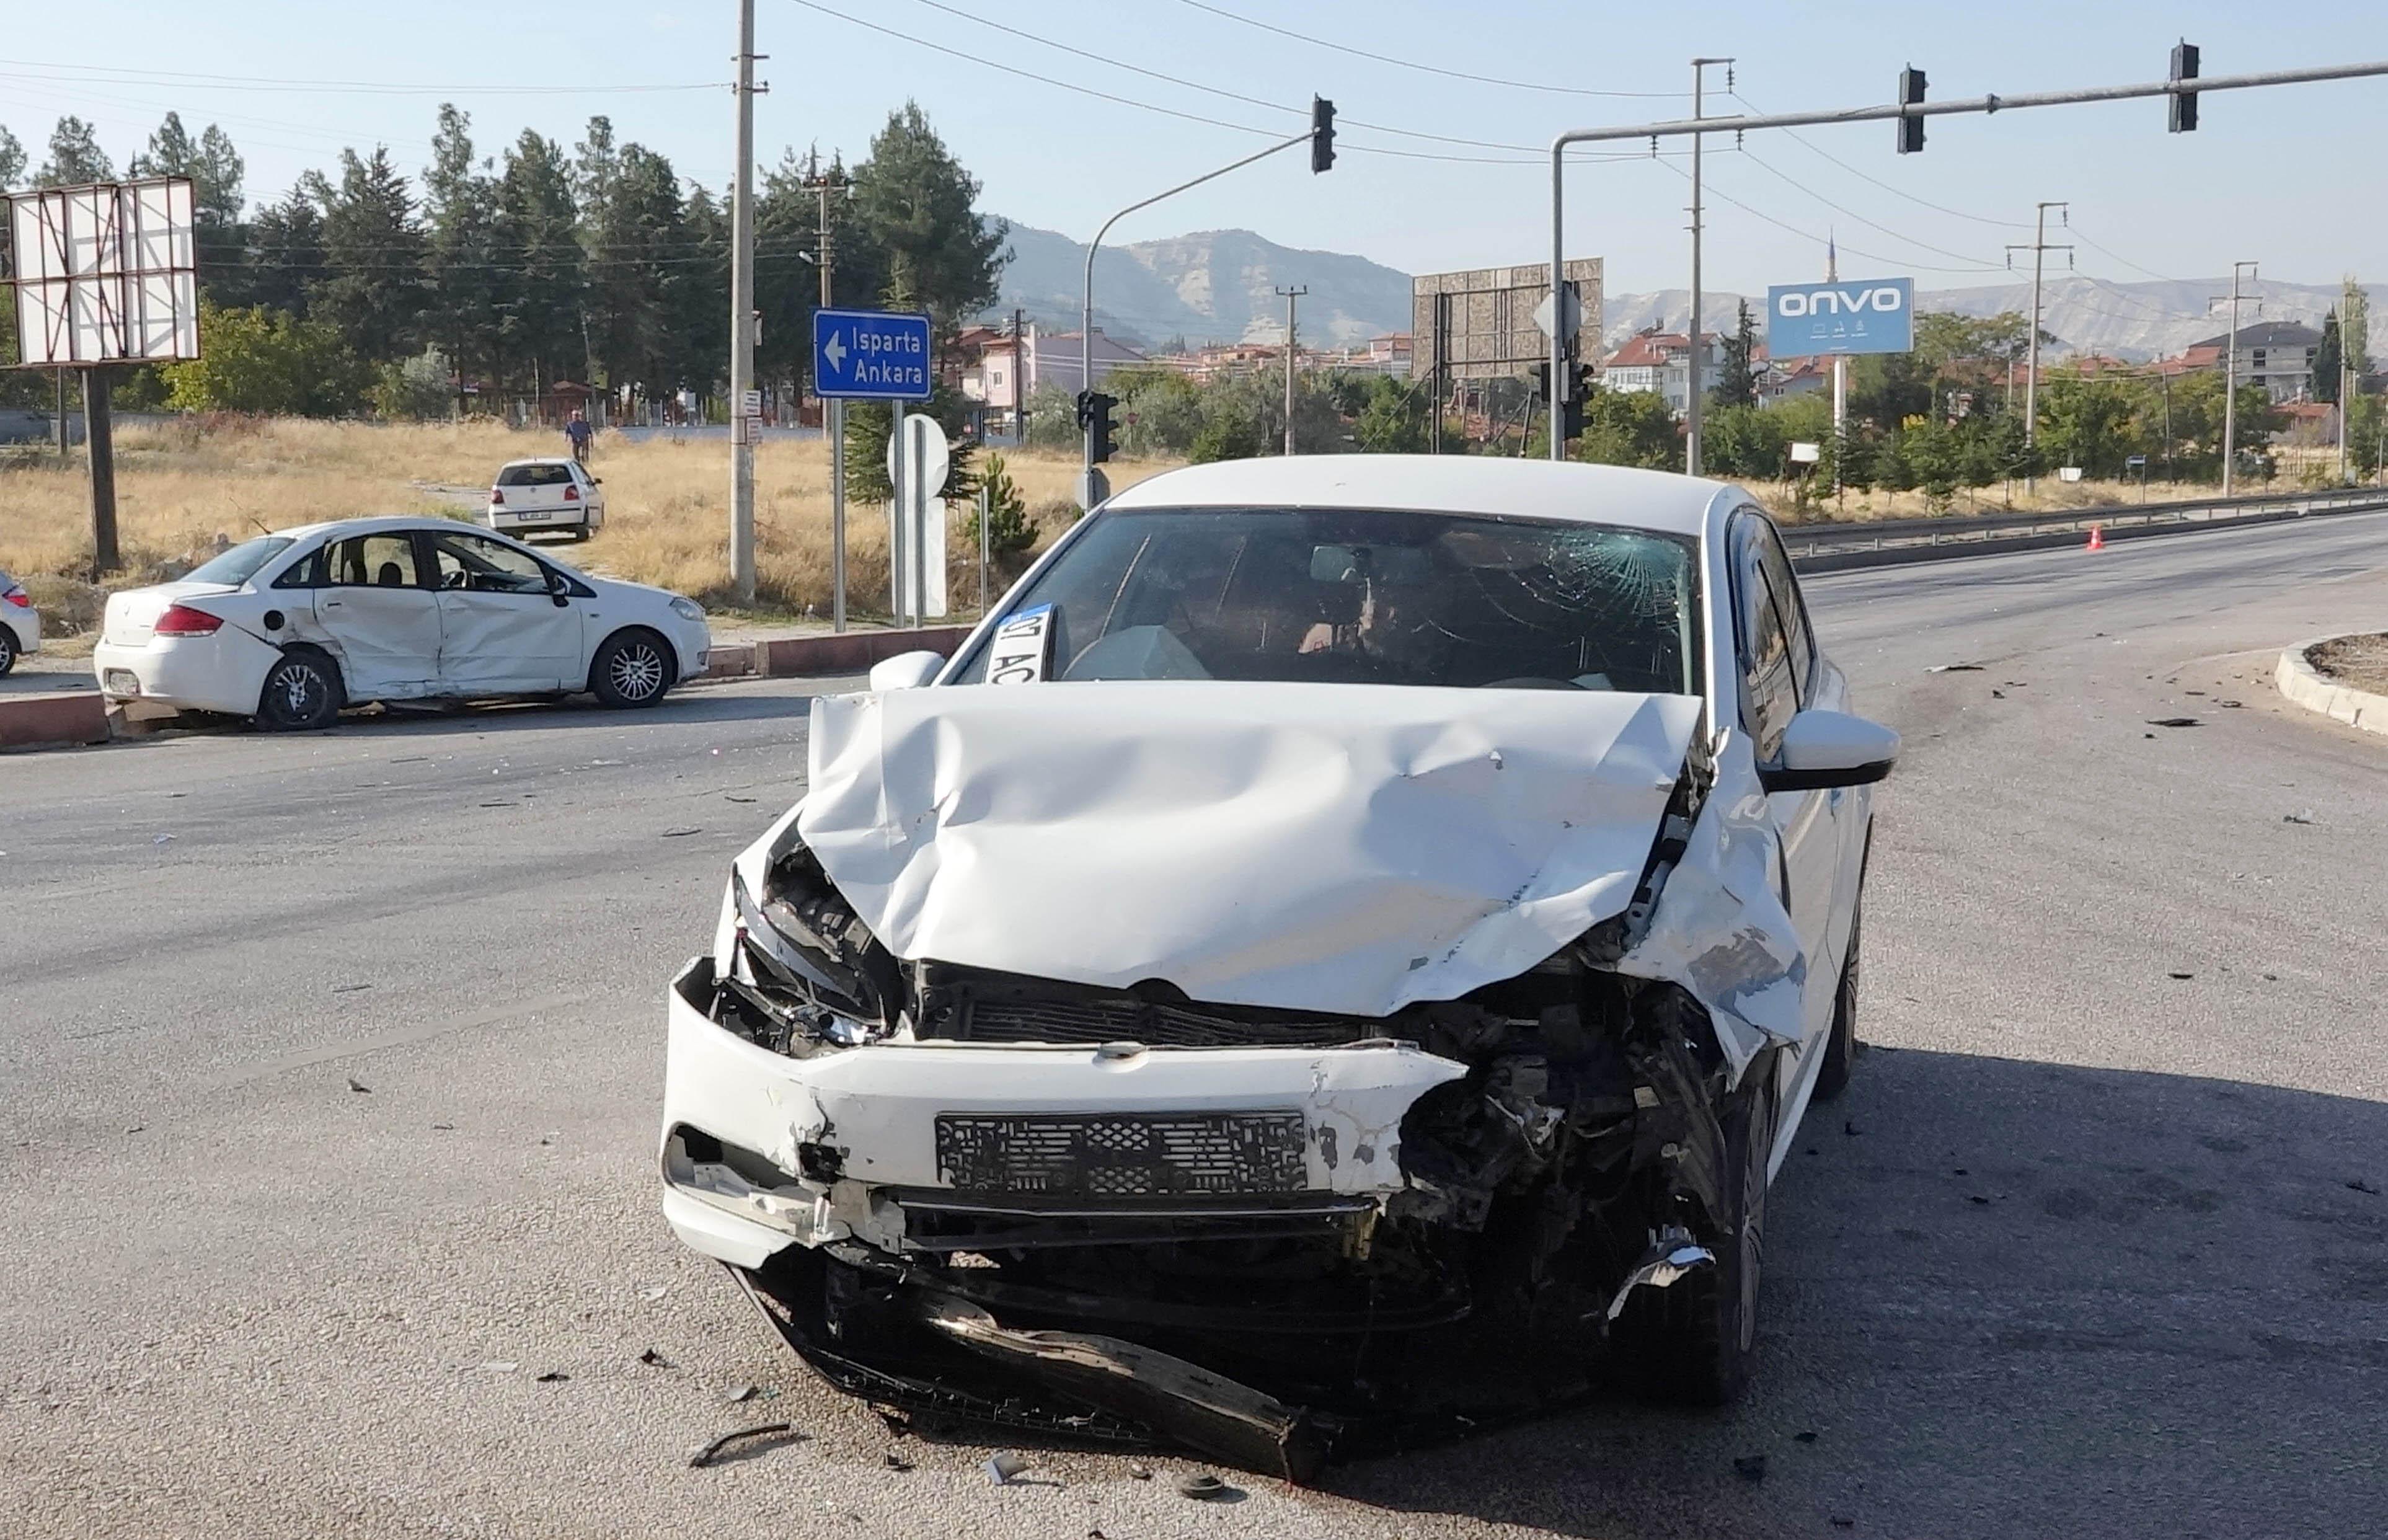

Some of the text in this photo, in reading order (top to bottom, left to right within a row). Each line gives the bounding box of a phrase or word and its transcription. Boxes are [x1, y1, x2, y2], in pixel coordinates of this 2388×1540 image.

[852, 326, 921, 358] Isparta
[854, 358, 922, 384] Ankara
[999, 616, 1043, 640] 07
